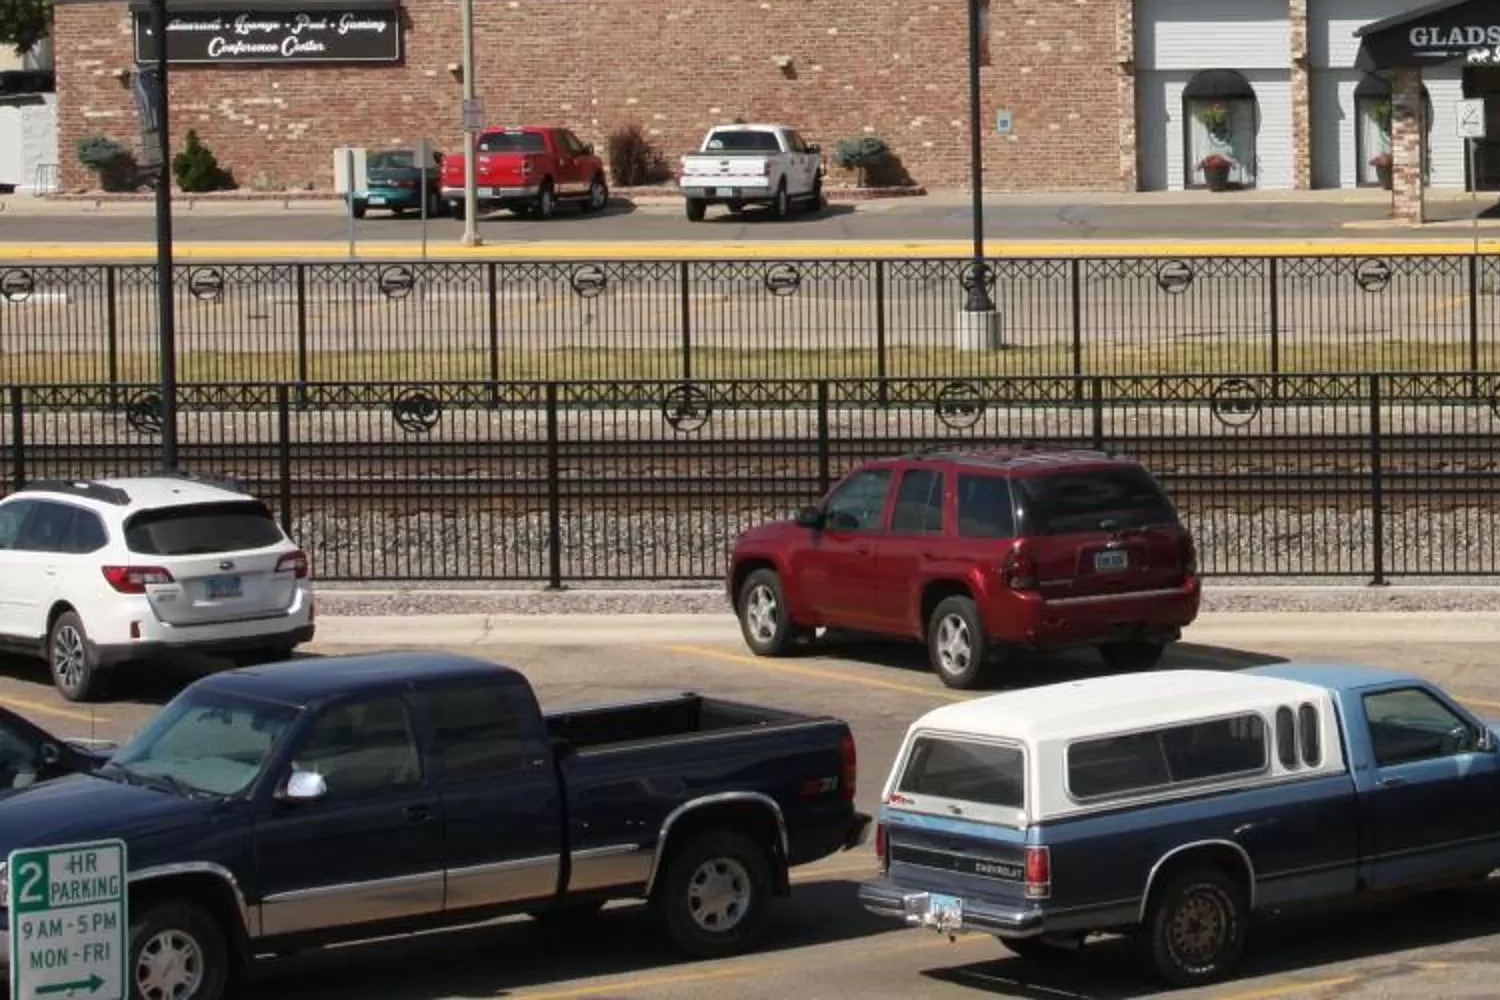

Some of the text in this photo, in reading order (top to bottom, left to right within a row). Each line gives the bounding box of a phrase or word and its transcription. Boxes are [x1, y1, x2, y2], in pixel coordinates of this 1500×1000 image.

[207, 35, 325, 57] Conference Center
[71, 852, 97, 875] HR
[19, 861, 44, 904] 2
[51, 875, 119, 902] PARKING
[37, 917, 63, 938] AM
[93, 912, 117, 932] PM
